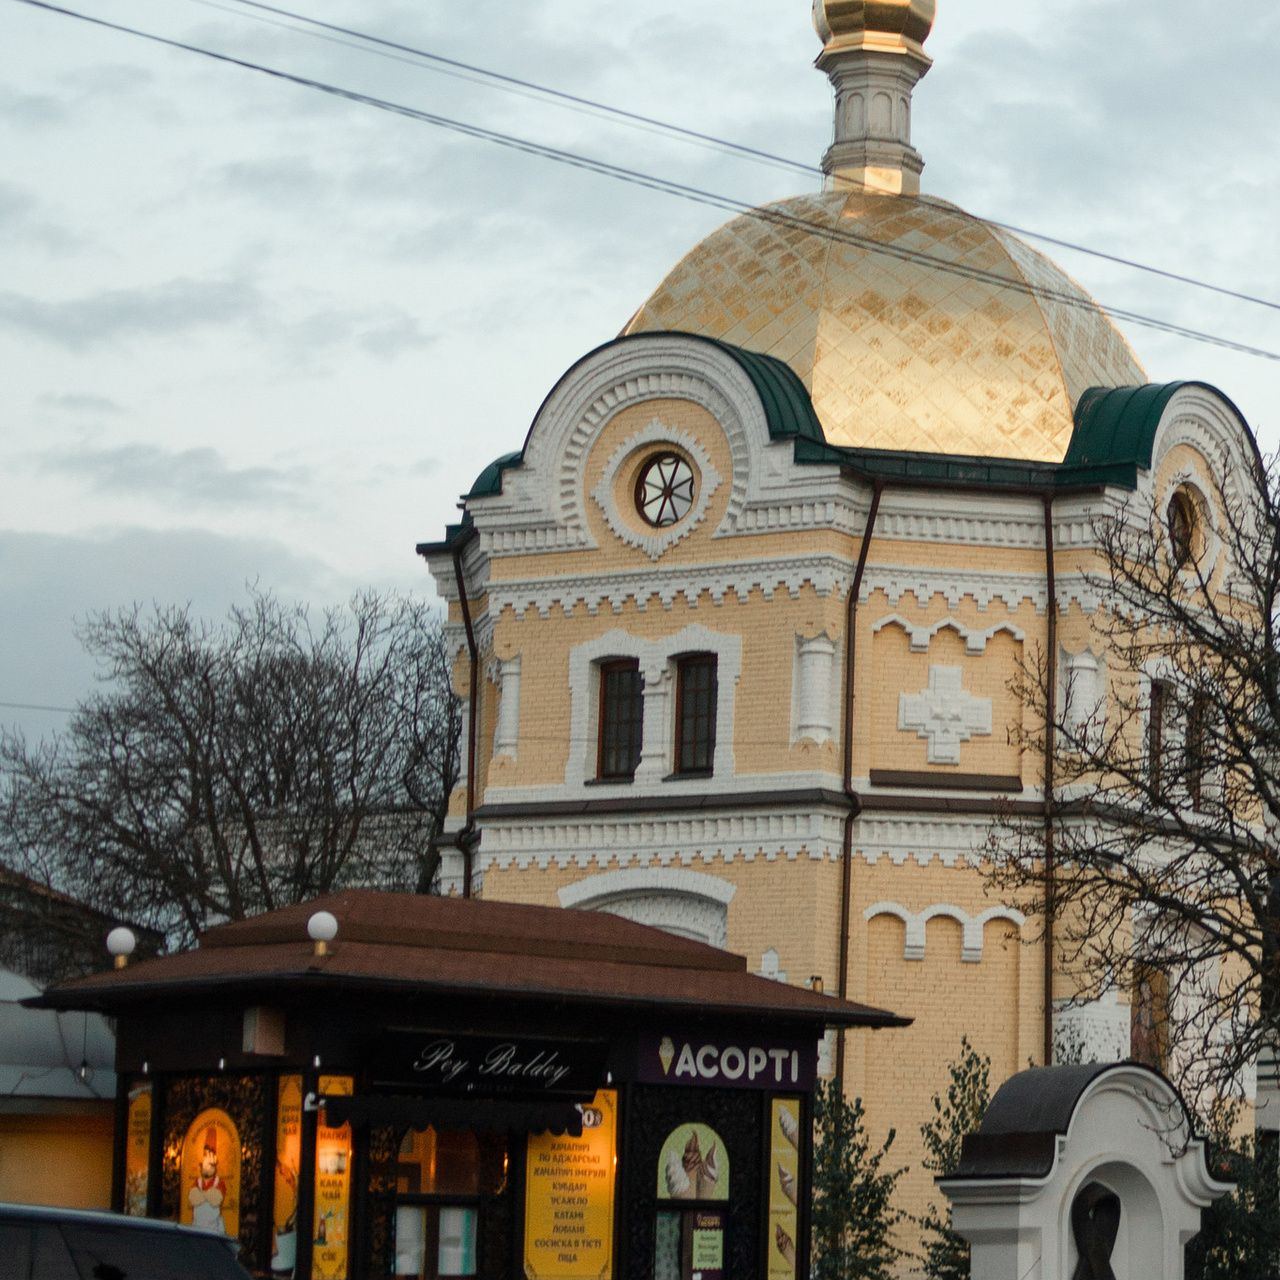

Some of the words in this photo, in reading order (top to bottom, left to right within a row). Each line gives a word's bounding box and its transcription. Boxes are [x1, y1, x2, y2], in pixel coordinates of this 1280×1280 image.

[539, 1153, 551, 1162] ПО
[552, 1153, 601, 1164] АДЖАРСЬКІ
[320, 1180, 343, 1188] КАВА
[322, 1189, 341, 1199] ЧАЙ
[534, 1239, 573, 1249] СОСИСКА
[574, 1239, 580, 1248] В
[581, 1239, 602, 1249] ТІСТІ
[321, 1252, 337, 1261] СІК
[557, 1253, 578, 1263] ПІЦА
